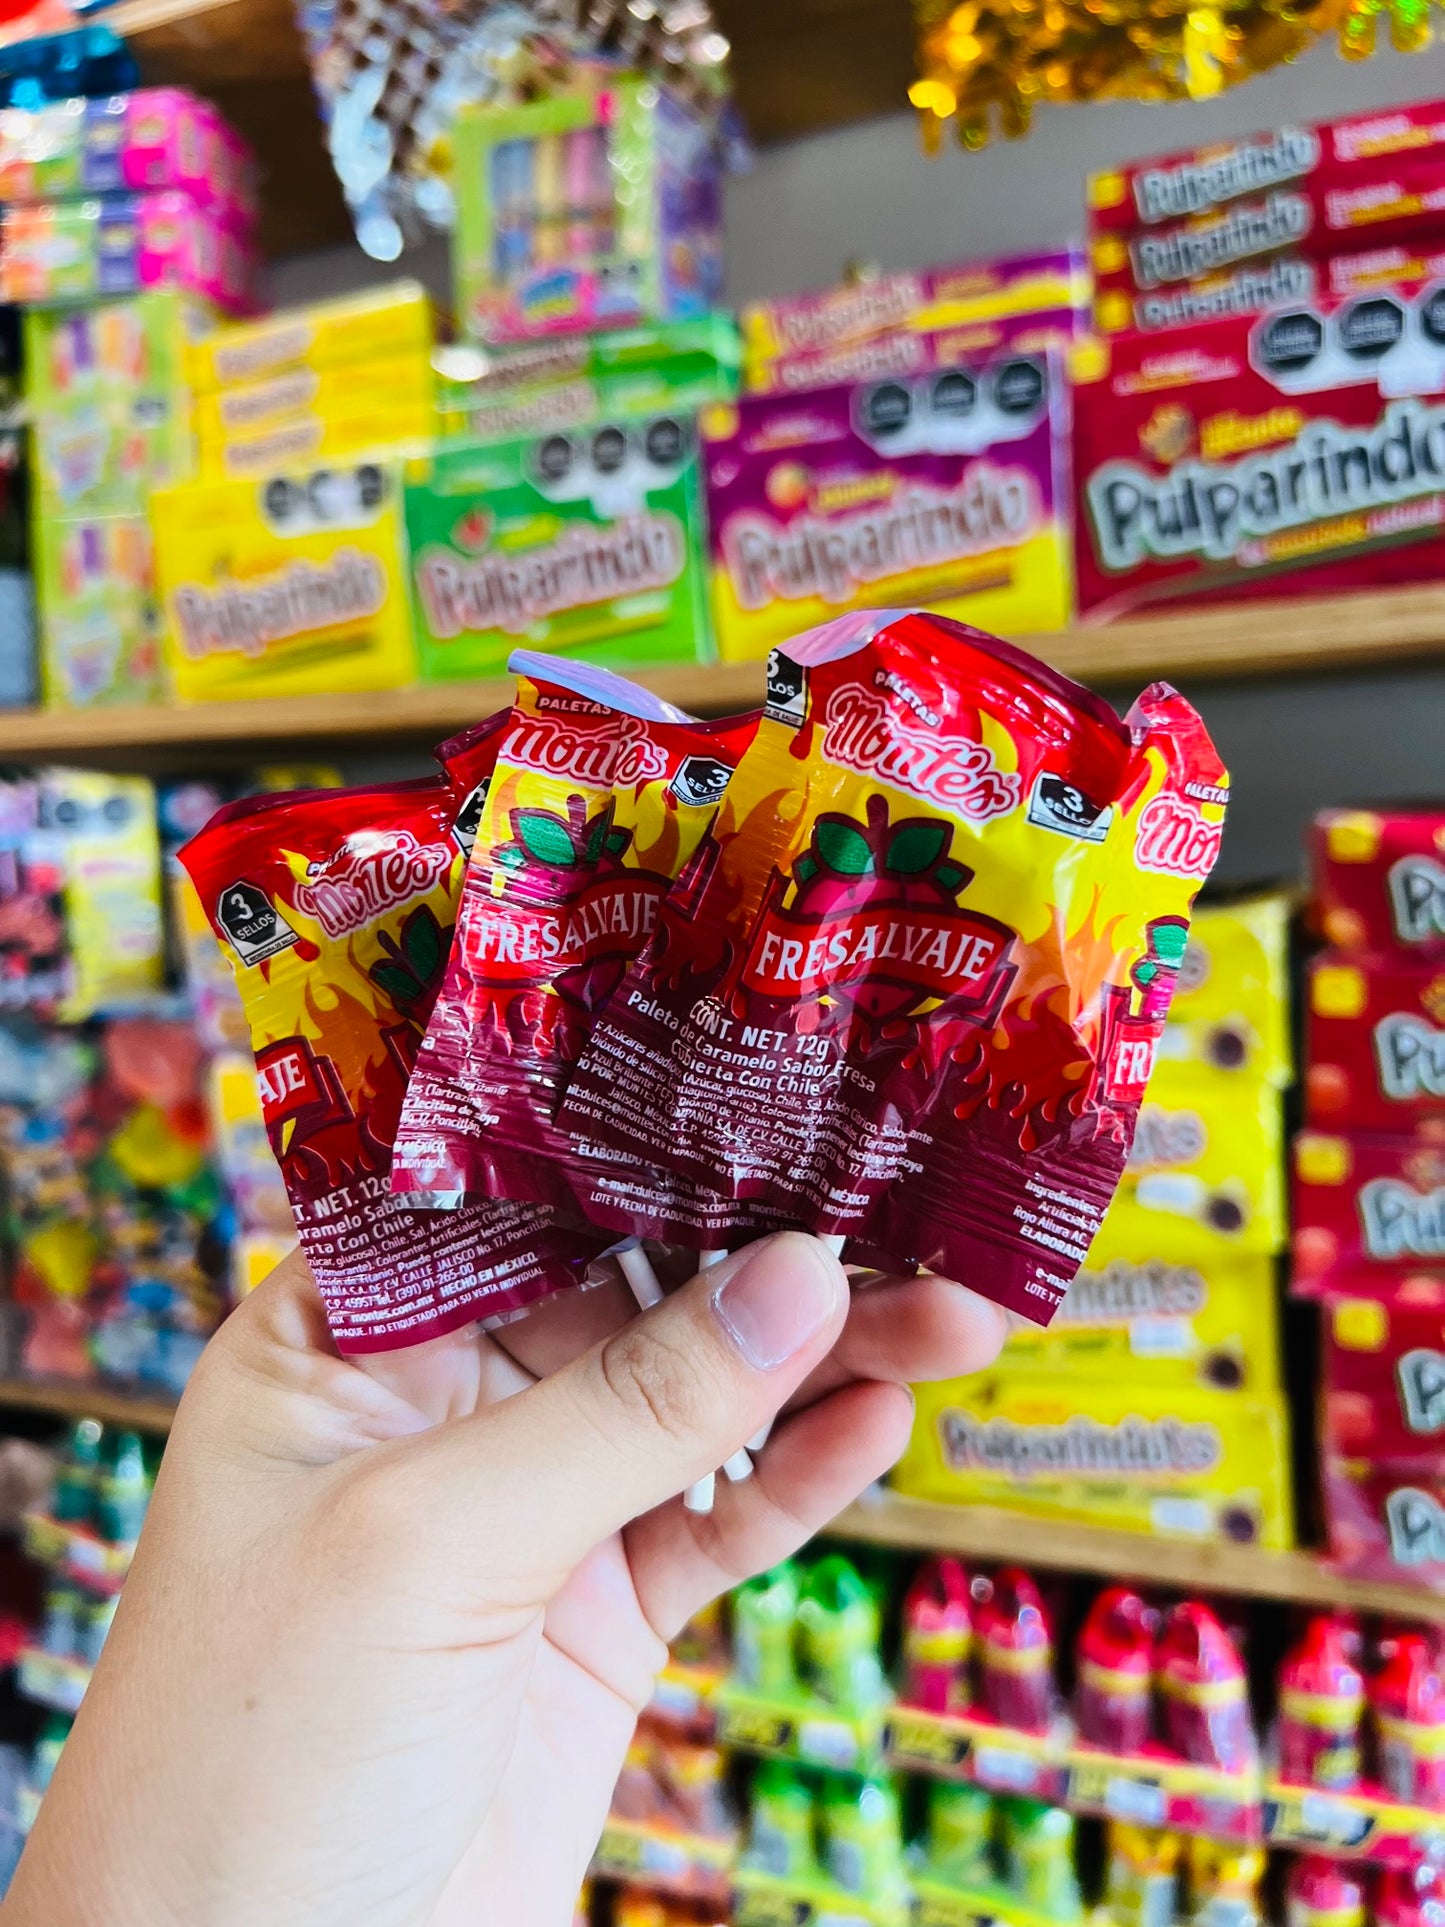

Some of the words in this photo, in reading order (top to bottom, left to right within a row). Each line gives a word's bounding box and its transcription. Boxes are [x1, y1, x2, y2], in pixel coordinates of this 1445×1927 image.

[539, 697, 612, 715] PALETAS
[875, 671, 941, 727] PALETAS
[707, 769, 730, 787] 3
[1062, 787, 1083, 813] 3
[231, 893, 253, 920] 3
[237, 913, 275, 939] SELLOS
[475, 893, 660, 963] FRESALVAJE
[755, 923, 994, 981] FRESALVAJE
[590, 1032, 626, 1060] Dióxido
[626, 1053, 639, 1067] de
[603, 1024, 647, 1054] Azúcares
[627, 990, 679, 1030] Paleta
[680, 1022, 695, 1043] de
[695, 1035, 777, 1071] Caramelo
[780, 1057, 831, 1077] Sabor
[834, 1060, 876, 1092] Fresa
[690, 1000, 732, 1042] CONT.
[741, 1026, 787, 1052] NET.
[795, 1035, 830, 1063] 12g
[671, 1039, 734, 1081] Cubierta
[739, 1071, 771, 1090] Con
[776, 1075, 820, 1096] Chile
[458, 1104, 473, 1116] de
[473, 1112, 500, 1126] soya
[591, 1050, 612, 1067] Azul
[613, 1061, 654, 1088] Brillante
[719, 1105, 732, 1117] de
[897, 1156, 924, 1173] soya
[608, 1087, 641, 1112] Jalisco,
[563, 1099, 591, 1116] FECHA
[592, 1109, 603, 1121] DE
[651, 1136, 666, 1150] VER
[714, 1162, 726, 1174] NO
[773, 1176, 793, 1191] PARA
[735, 1125, 751, 1138] DE
[770, 1132, 803, 1151] CALLE
[313, 1187, 359, 1219] NET.
[590, 1191, 612, 1205] LOTE
[612, 1196, 620, 1207] Y
[620, 1198, 646, 1213] FECHA
[706, 1219, 721, 1229] VER
[1024, 1179, 1100, 1216] Ingredientes:
[337, 1233, 370, 1252] Con
[372, 1214, 415, 1240] Chile
[381, 1235, 409, 1252] Chile,
[430, 1214, 457, 1232] Ácido
[397, 1254, 431, 1272] Puede
[433, 1233, 478, 1258] contener
[480, 1215, 521, 1238] lecitina
[521, 1209, 535, 1220] de
[1013, 1205, 1036, 1224] Rojo
[1037, 1216, 1069, 1238] Allura
[375, 1242, 429, 1267] Colorantes
[430, 1218, 482, 1247] Artificiales
[1020, 1225, 1088, 1263] ELABORADO
[395, 1283, 421, 1301] (391)
[423, 1262, 475, 1290] 91-265-00
[402, 1264, 433, 1283] CALLE
[437, 1248, 475, 1272] JALISCO
[351, 1294, 435, 1323] montes.com.mx
[440, 1274, 477, 1298] HECHO
[477, 1268, 494, 1283] EN
[373, 1324, 386, 1334] NO
[386, 1308, 437, 1332] ETIQUETADO
[438, 1298, 460, 1315] PARA
[459, 1293, 471, 1305] SU
[472, 1284, 499, 1299] VENTA
[1024, 1280, 1048, 1299] LOTE
[1047, 1291, 1056, 1302] Y
